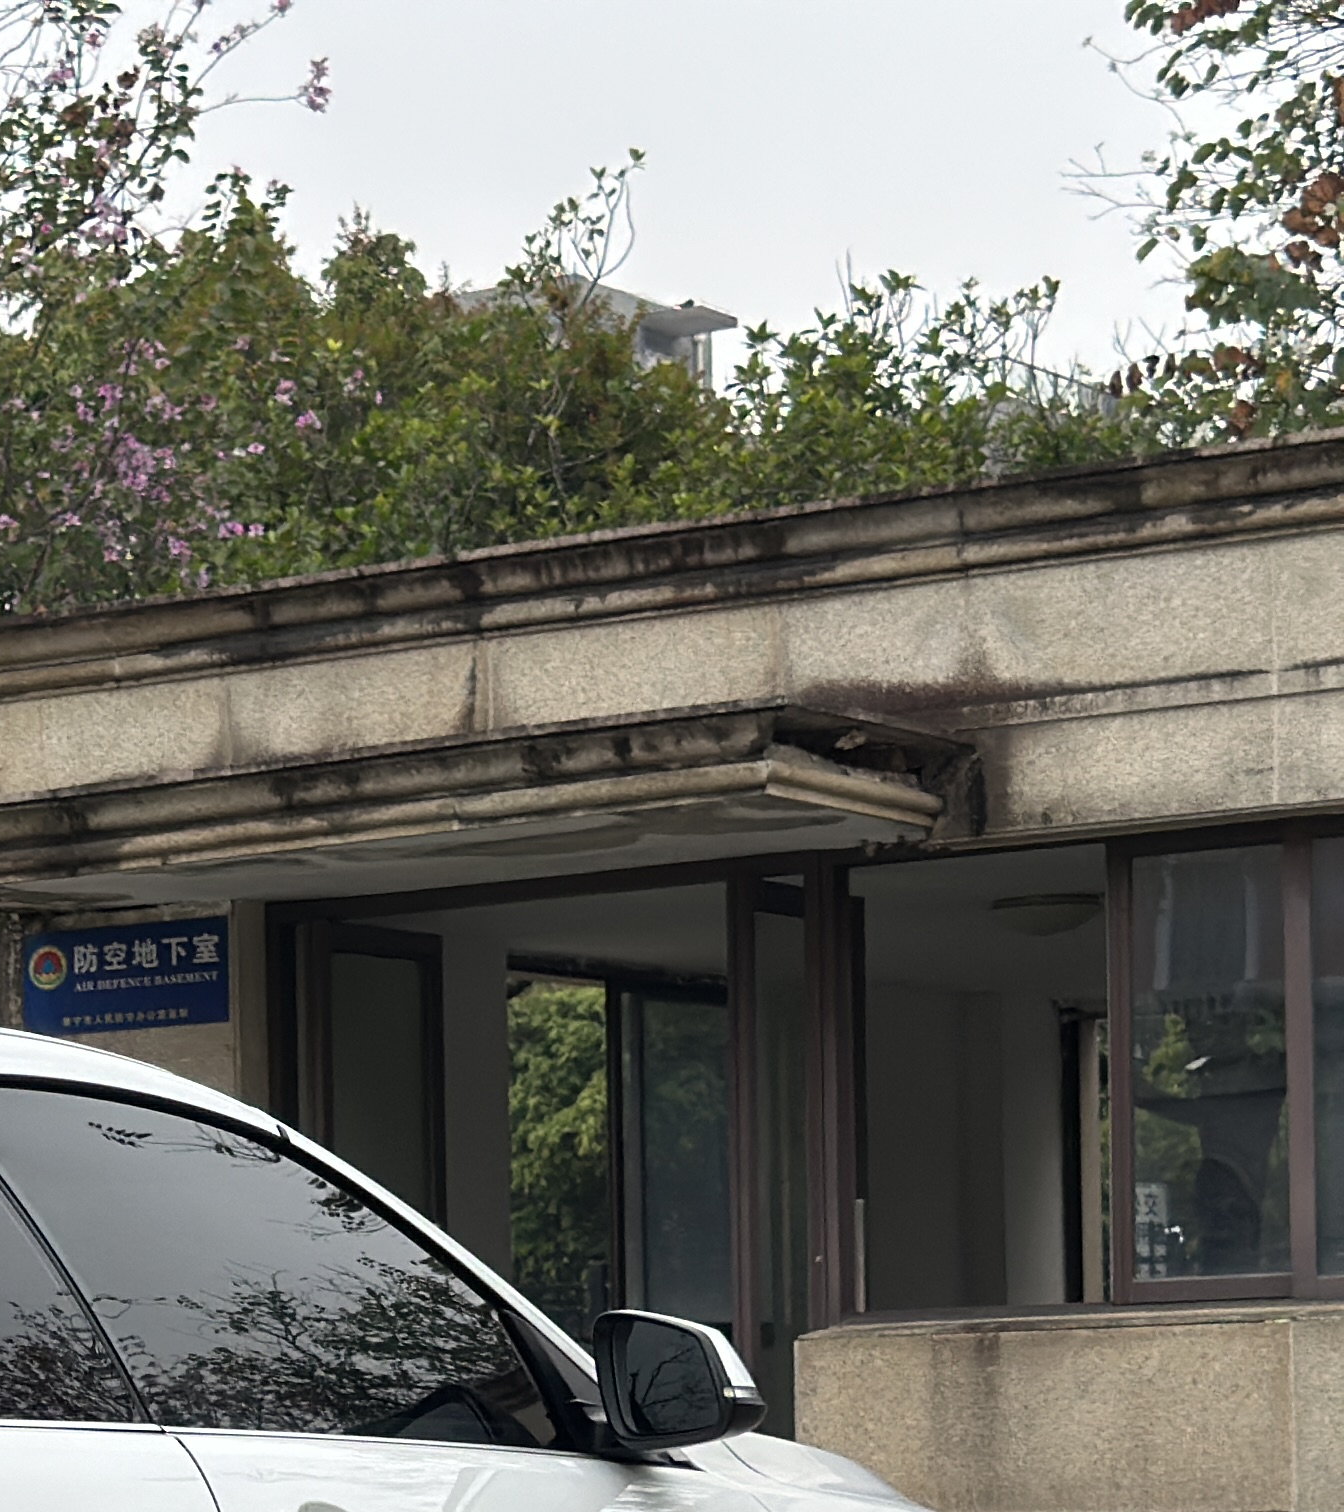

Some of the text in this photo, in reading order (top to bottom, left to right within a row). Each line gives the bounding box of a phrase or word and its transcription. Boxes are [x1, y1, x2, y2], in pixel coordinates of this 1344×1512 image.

[72, 933, 220, 975] 防空地下室
[74, 981, 95, 992] AIR
